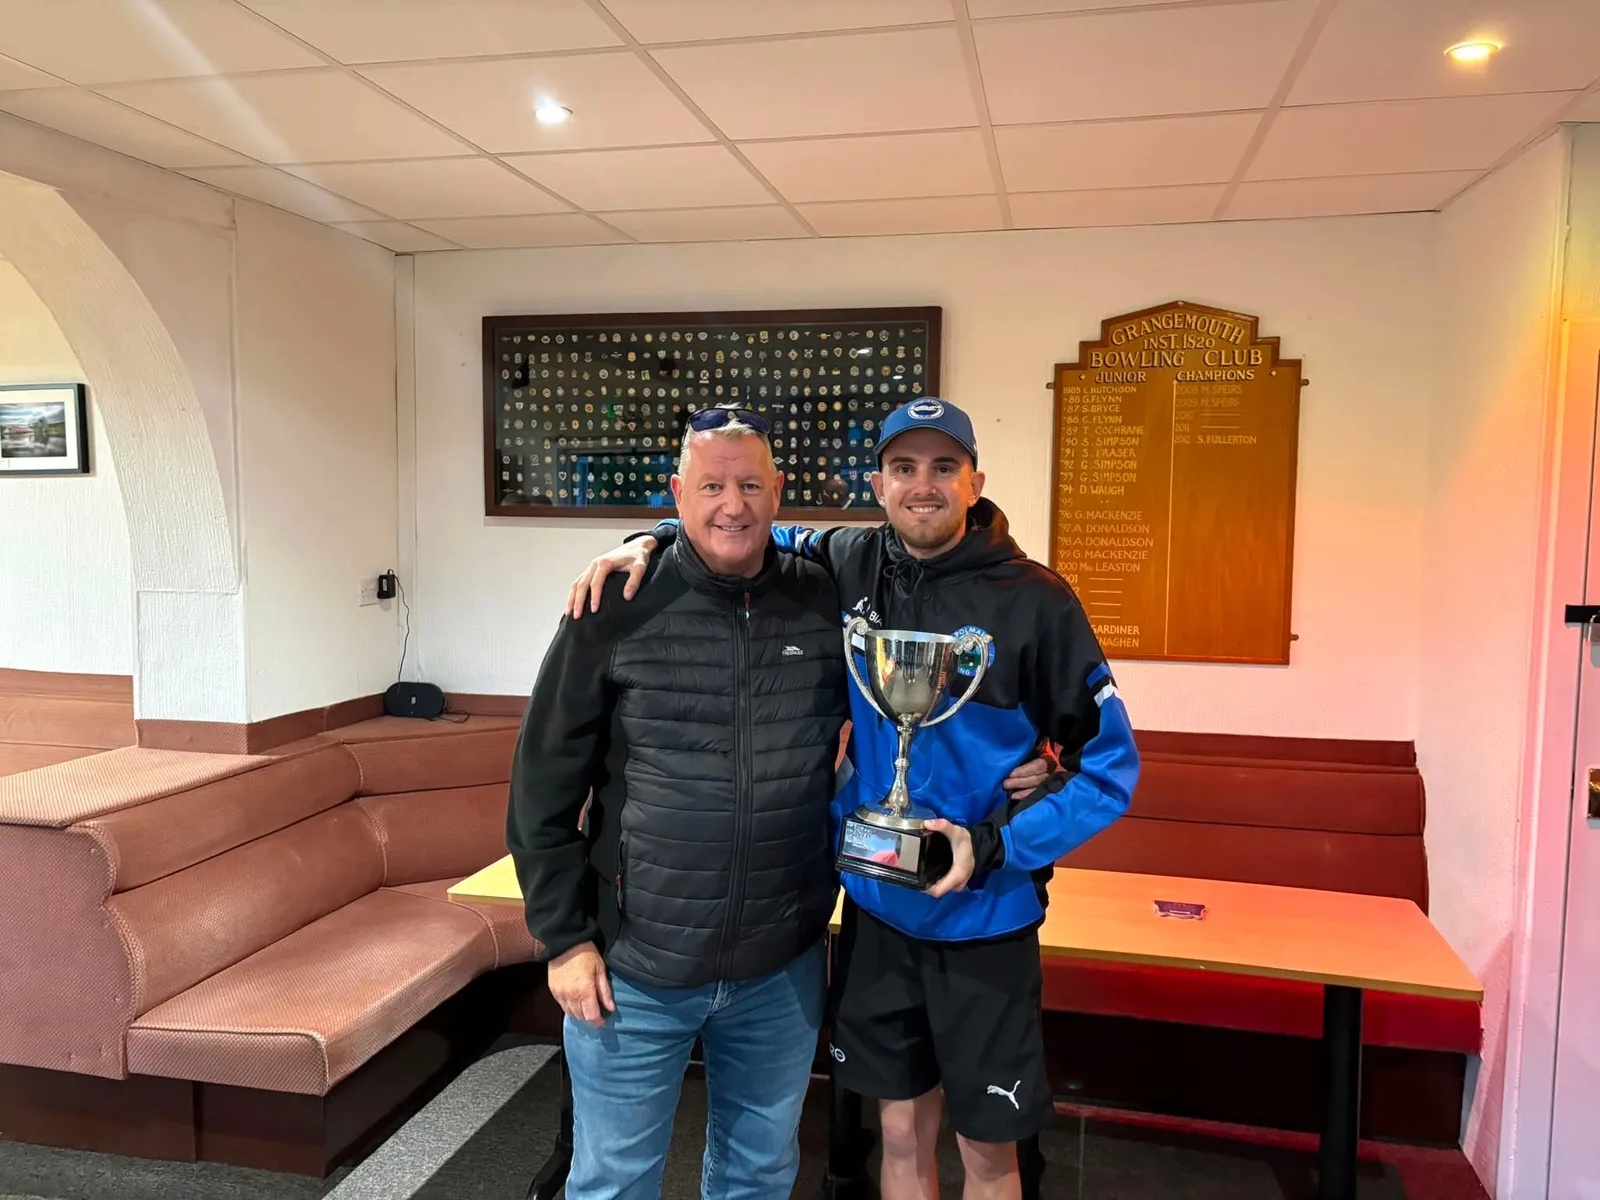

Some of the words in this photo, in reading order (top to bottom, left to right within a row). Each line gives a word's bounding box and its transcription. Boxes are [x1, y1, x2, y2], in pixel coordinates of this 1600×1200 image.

[1111, 313, 1245, 345] GRANGEMOUTH
[1144, 334, 1179, 350] INST.
[1182, 334, 1216, 349] 1820
[1090, 350, 1185, 368] BOWLING
[1204, 349, 1263, 366] CLUB
[1095, 371, 1146, 383] JUNIOR
[1177, 369, 1255, 382] CHAMPIONS
[1099, 636, 1140, 648] NAGHEN
